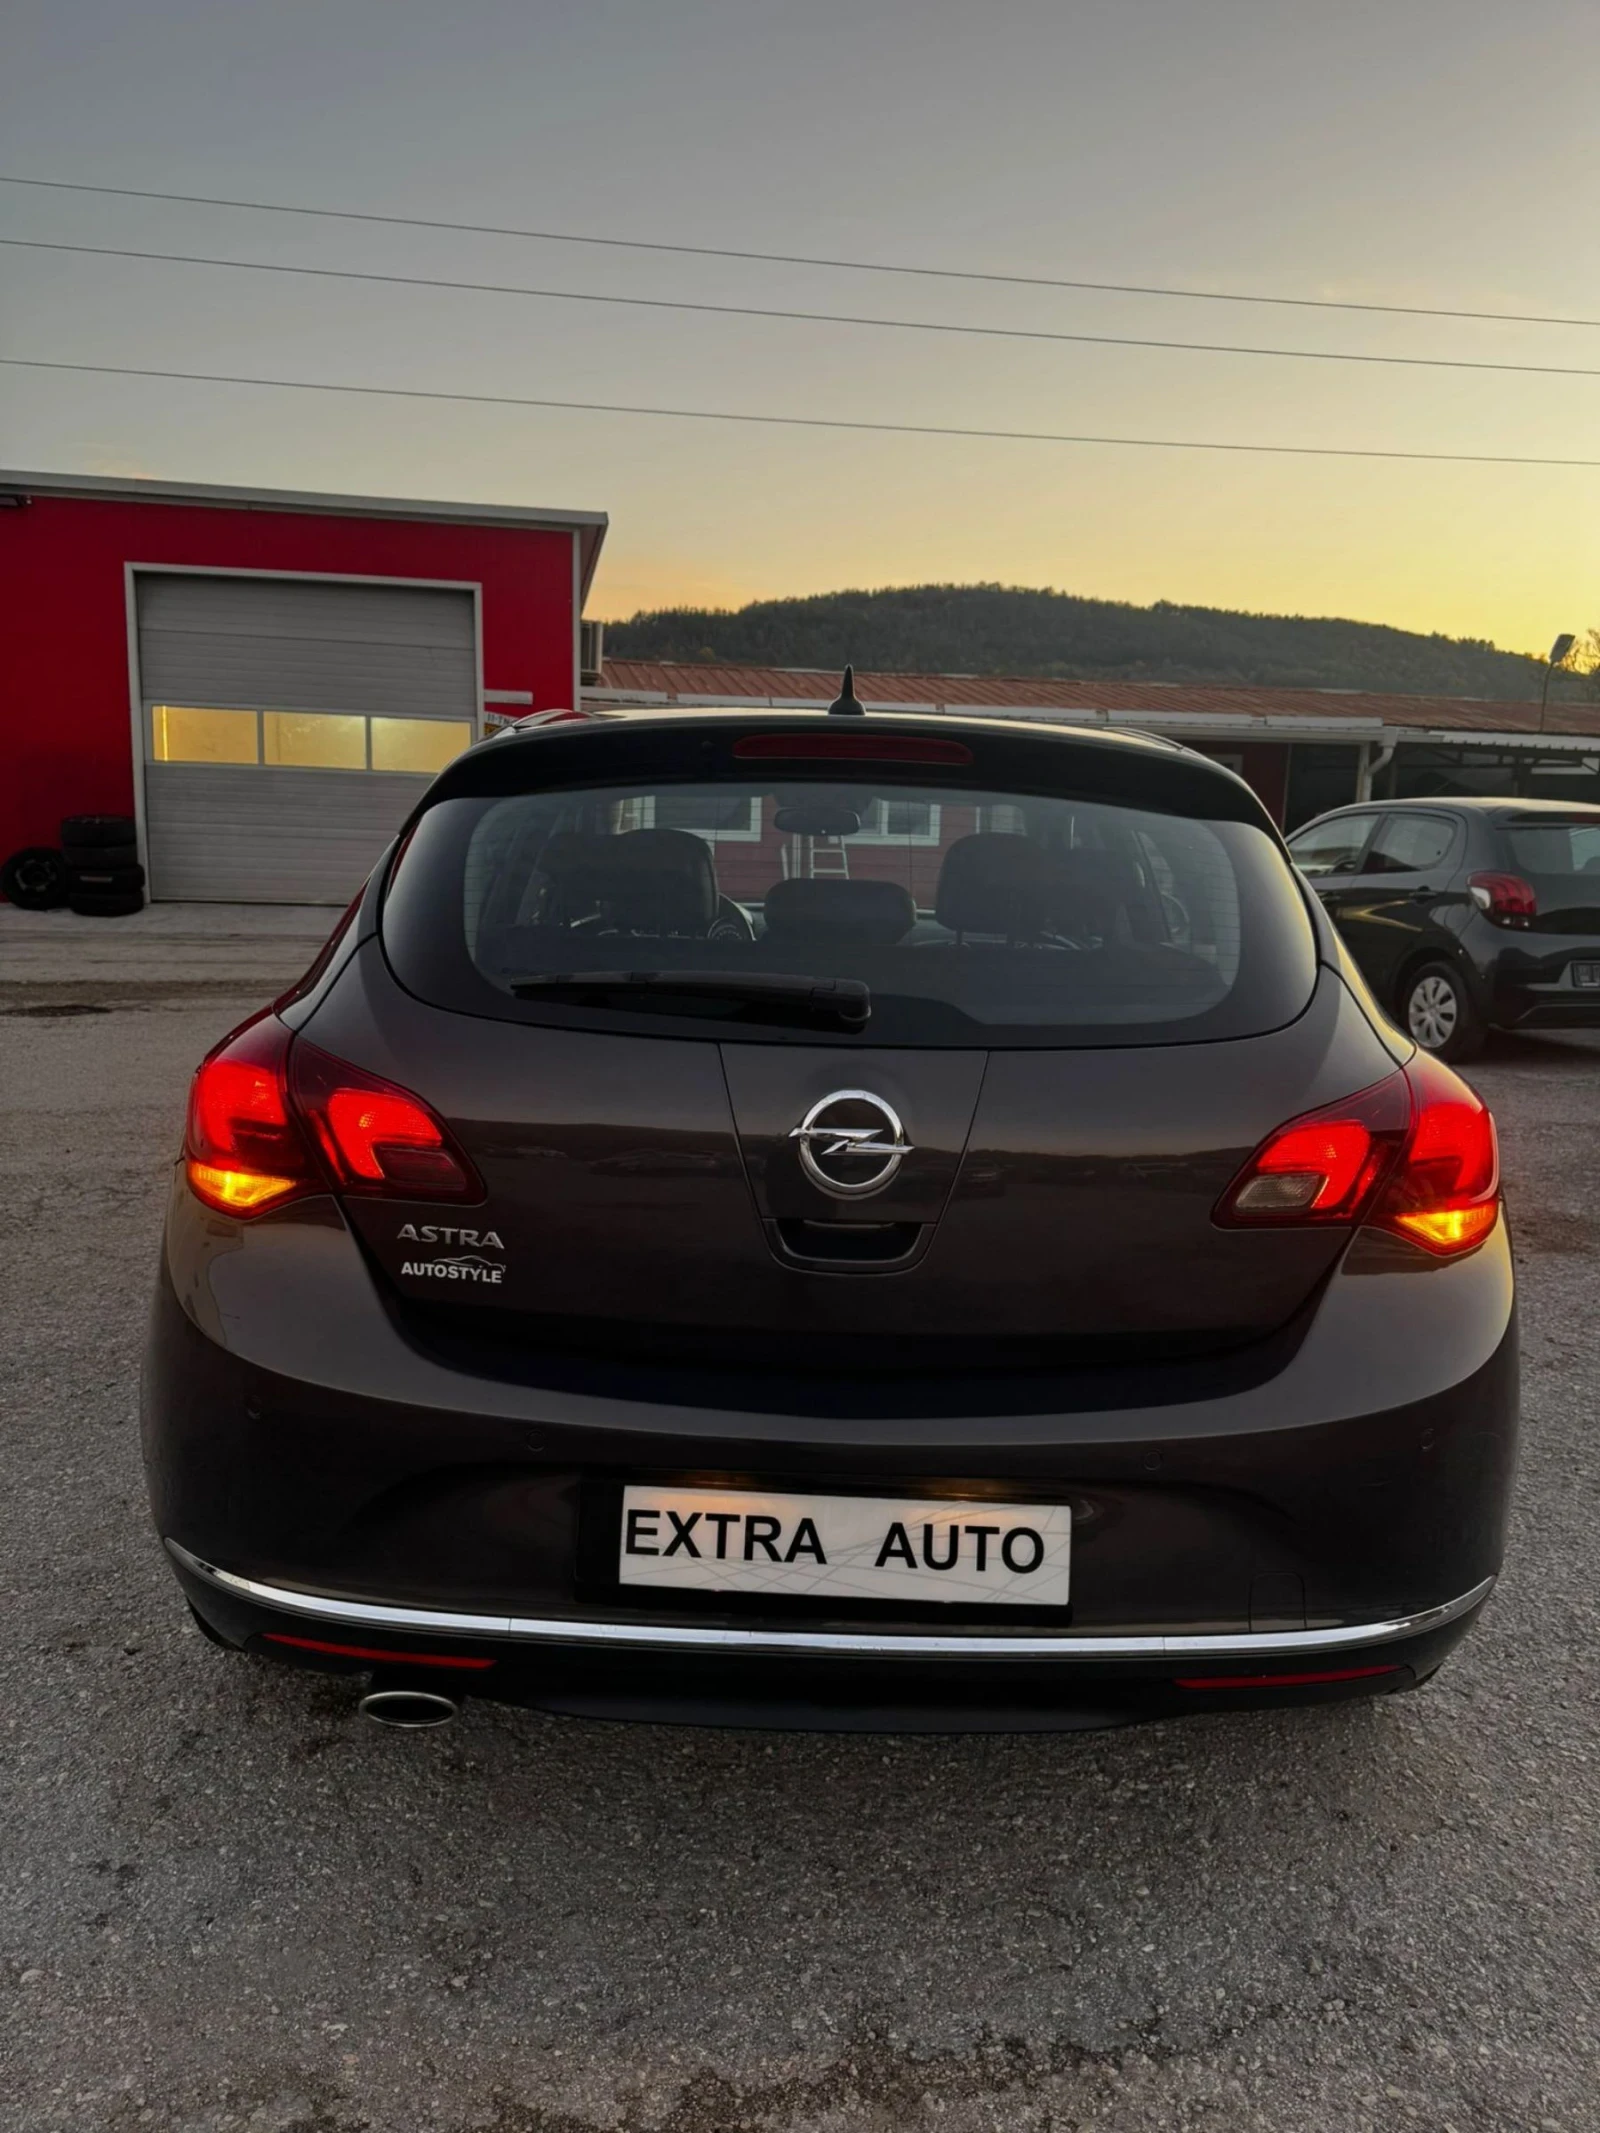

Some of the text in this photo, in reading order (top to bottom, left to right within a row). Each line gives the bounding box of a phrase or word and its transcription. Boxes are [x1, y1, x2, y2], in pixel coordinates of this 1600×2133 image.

[397, 1224, 505, 1249] ASTRA
[401, 1262, 502, 1283] AUTOSTYLE
[625, 1509, 1045, 1574] EXTRA AUTO
